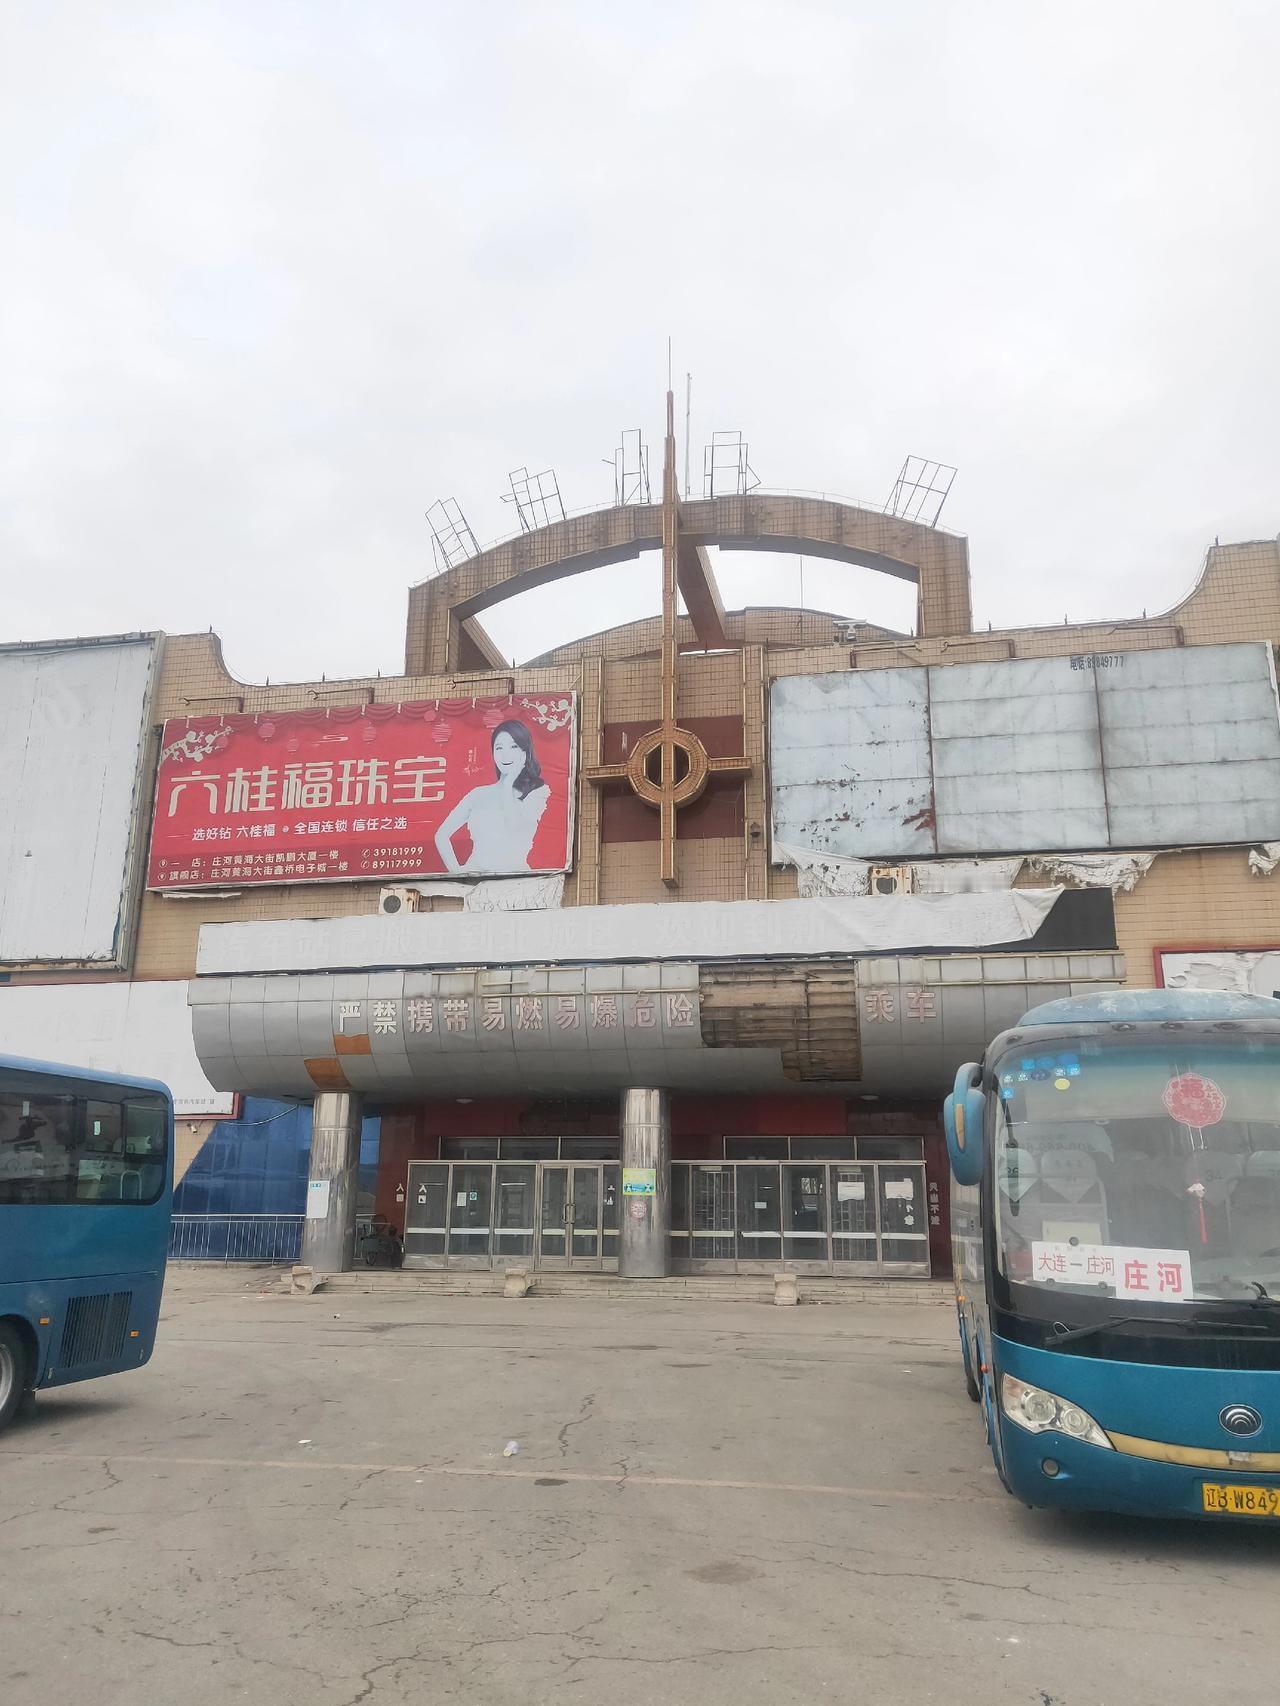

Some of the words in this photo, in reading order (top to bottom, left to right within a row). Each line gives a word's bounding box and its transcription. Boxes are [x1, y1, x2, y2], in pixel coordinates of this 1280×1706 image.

[168, 756, 447, 817] 六桂福珠宝
[192, 827, 232, 841] 选好钻
[236, 823, 276, 838] 六桂福
[294, 819, 347, 835] 全国连锁
[352, 816, 407, 832] 信任之选
[372, 859, 422, 869] 89117999
[373, 846, 423, 856] 39181999
[338, 994, 696, 1034] 严禁携带易燃易爆危险
[865, 987, 938, 1025] 乘车
[1124, 1259, 1183, 1293] 庄河
